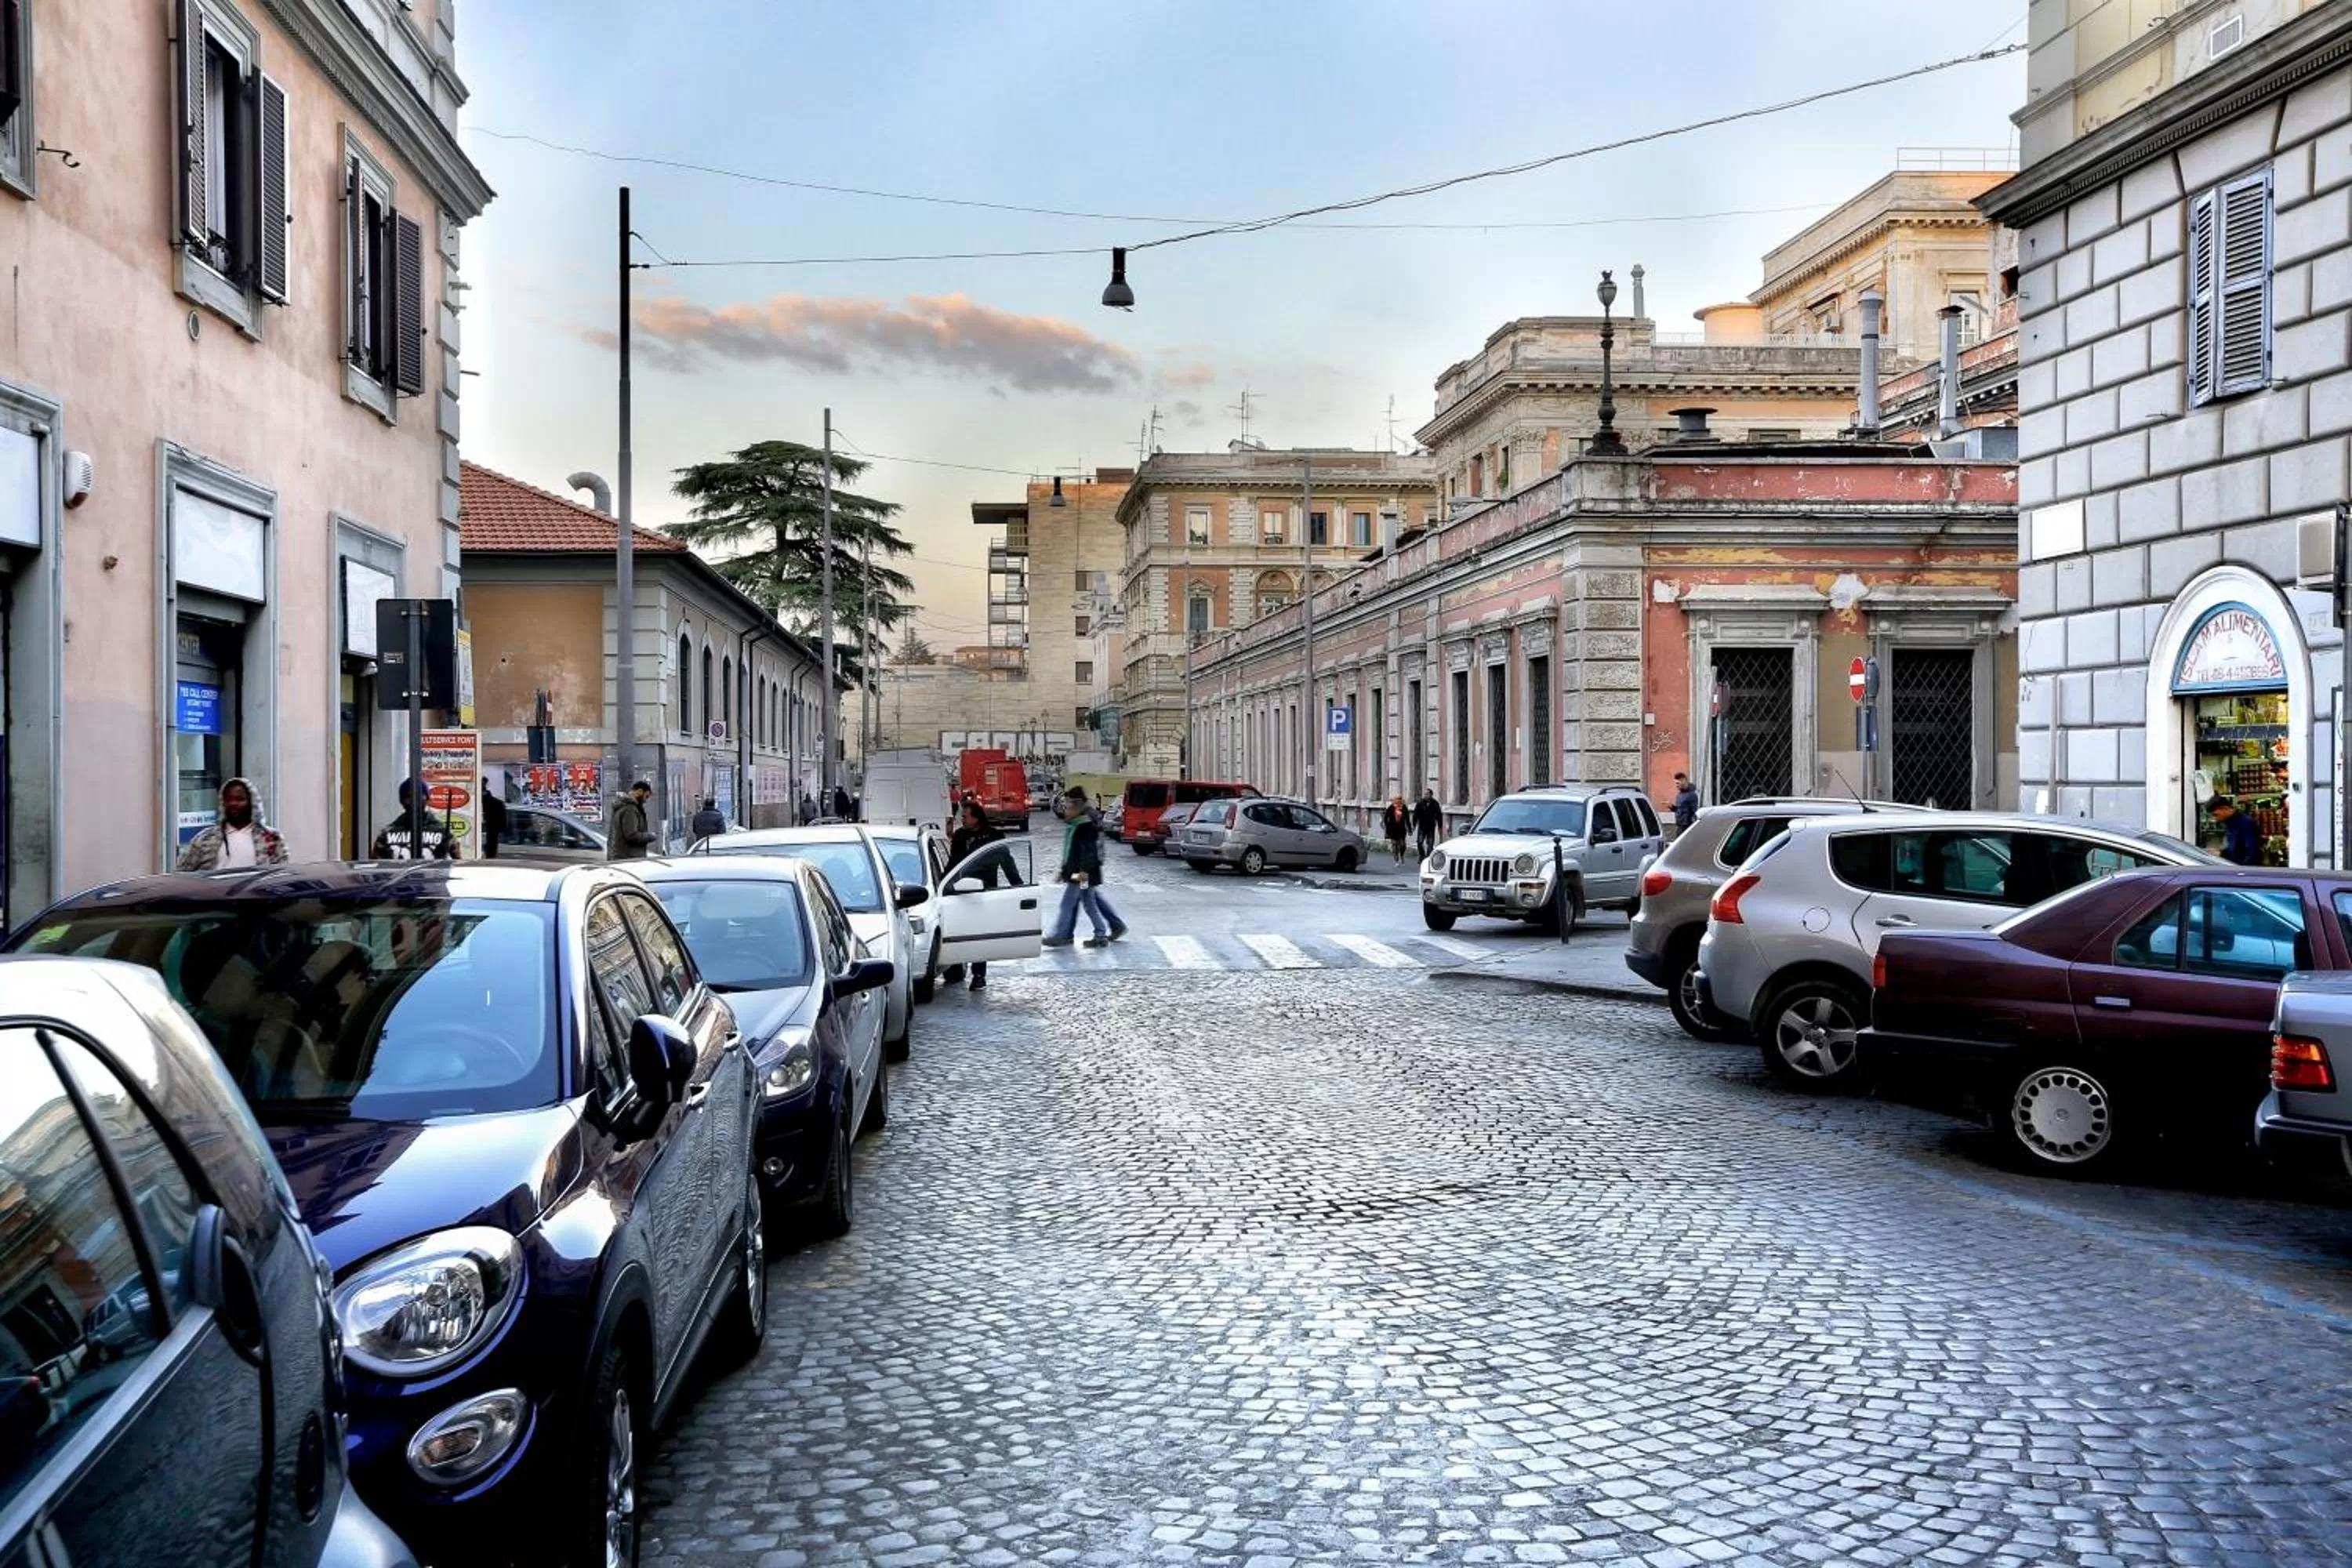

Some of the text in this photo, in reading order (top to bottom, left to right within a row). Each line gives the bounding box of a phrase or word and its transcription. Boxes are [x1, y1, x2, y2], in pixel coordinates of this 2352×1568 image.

[2213, 614, 2281, 677] ALIMENTARI
[1332, 710, 1346, 731] P
[387, 832, 443, 845] WAING
